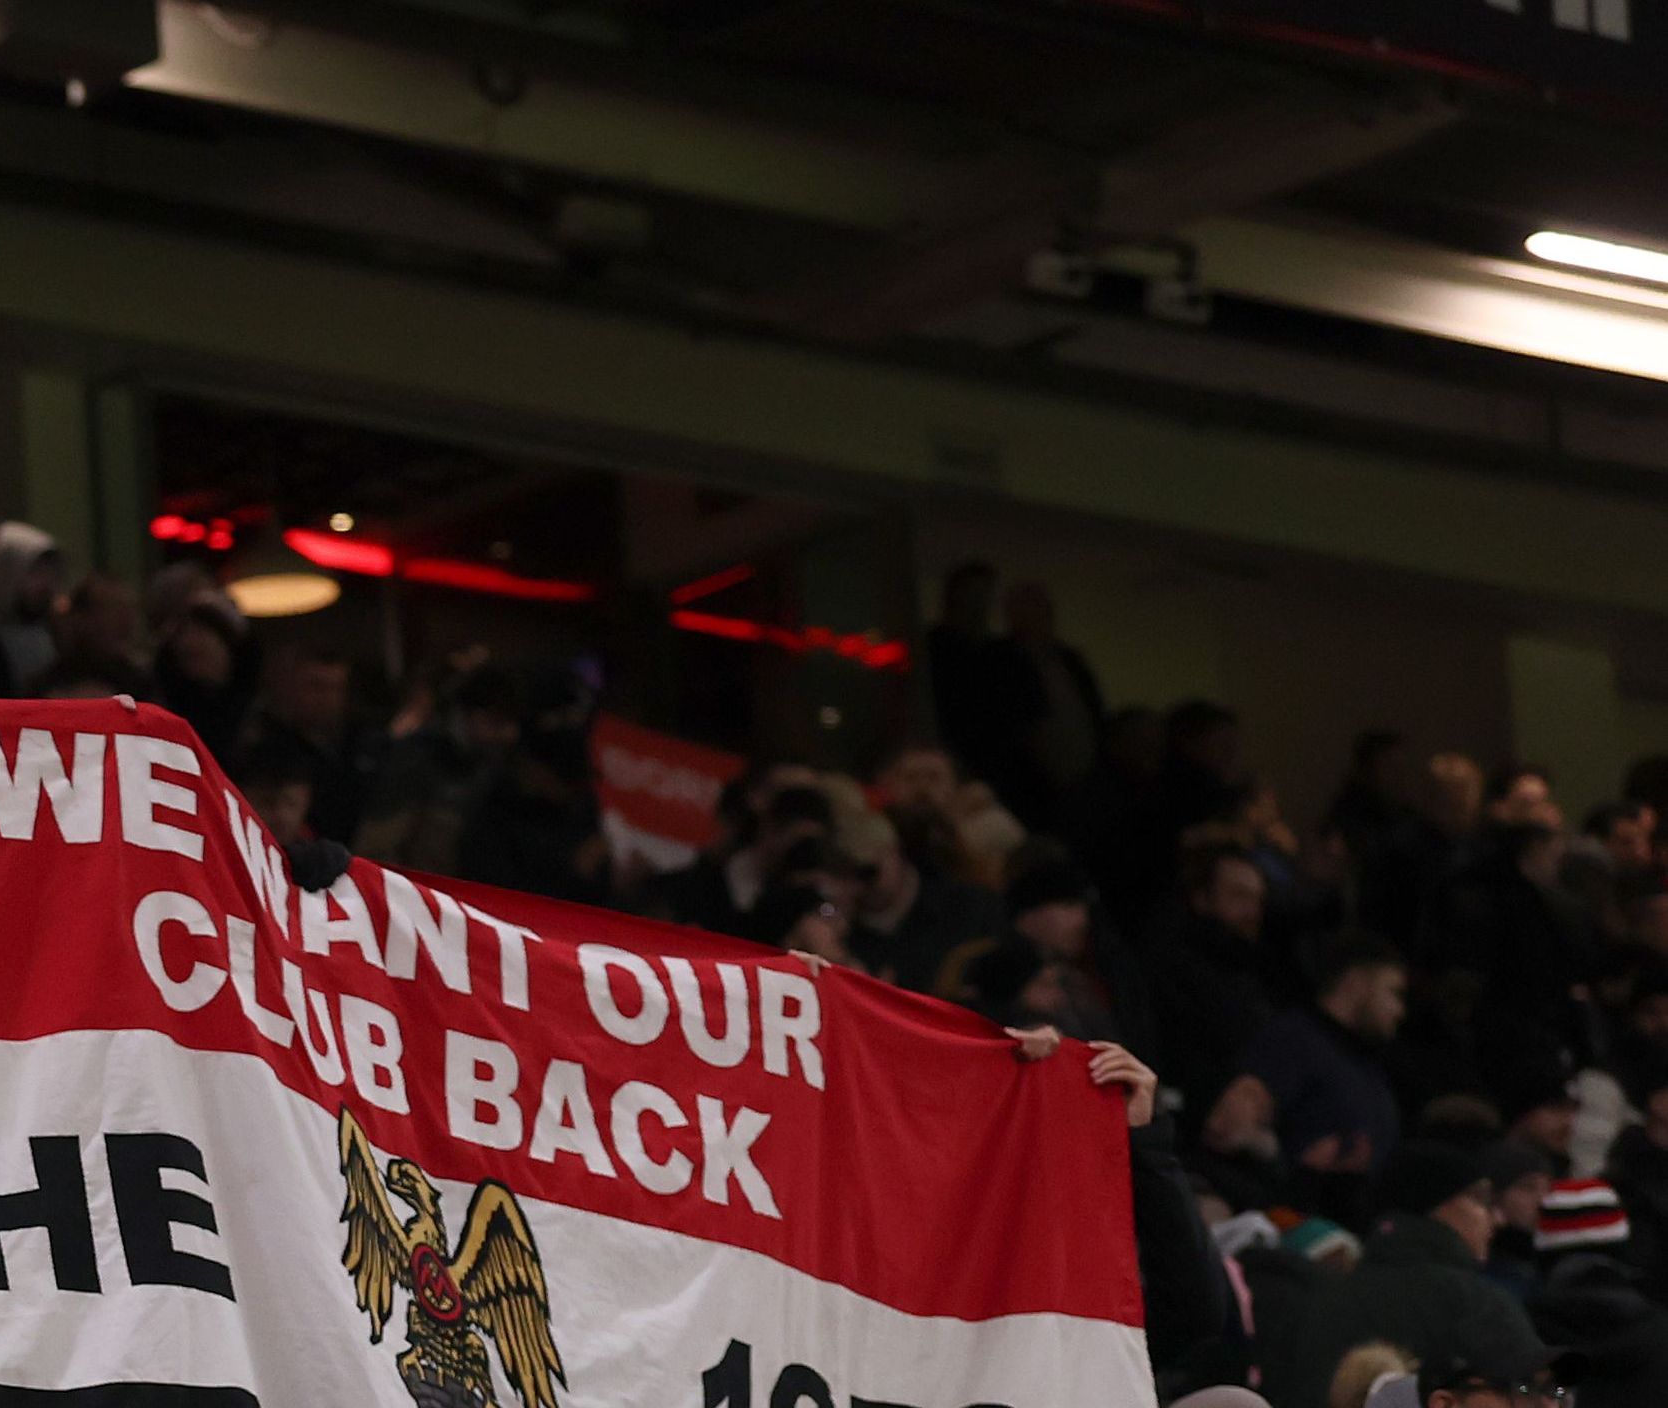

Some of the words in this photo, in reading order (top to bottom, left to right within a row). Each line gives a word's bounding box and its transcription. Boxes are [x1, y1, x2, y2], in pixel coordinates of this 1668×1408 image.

[133, 890, 411, 1115] CLUB
[444, 1029, 784, 1220] BACK
[577, 942, 826, 1092] OUR
